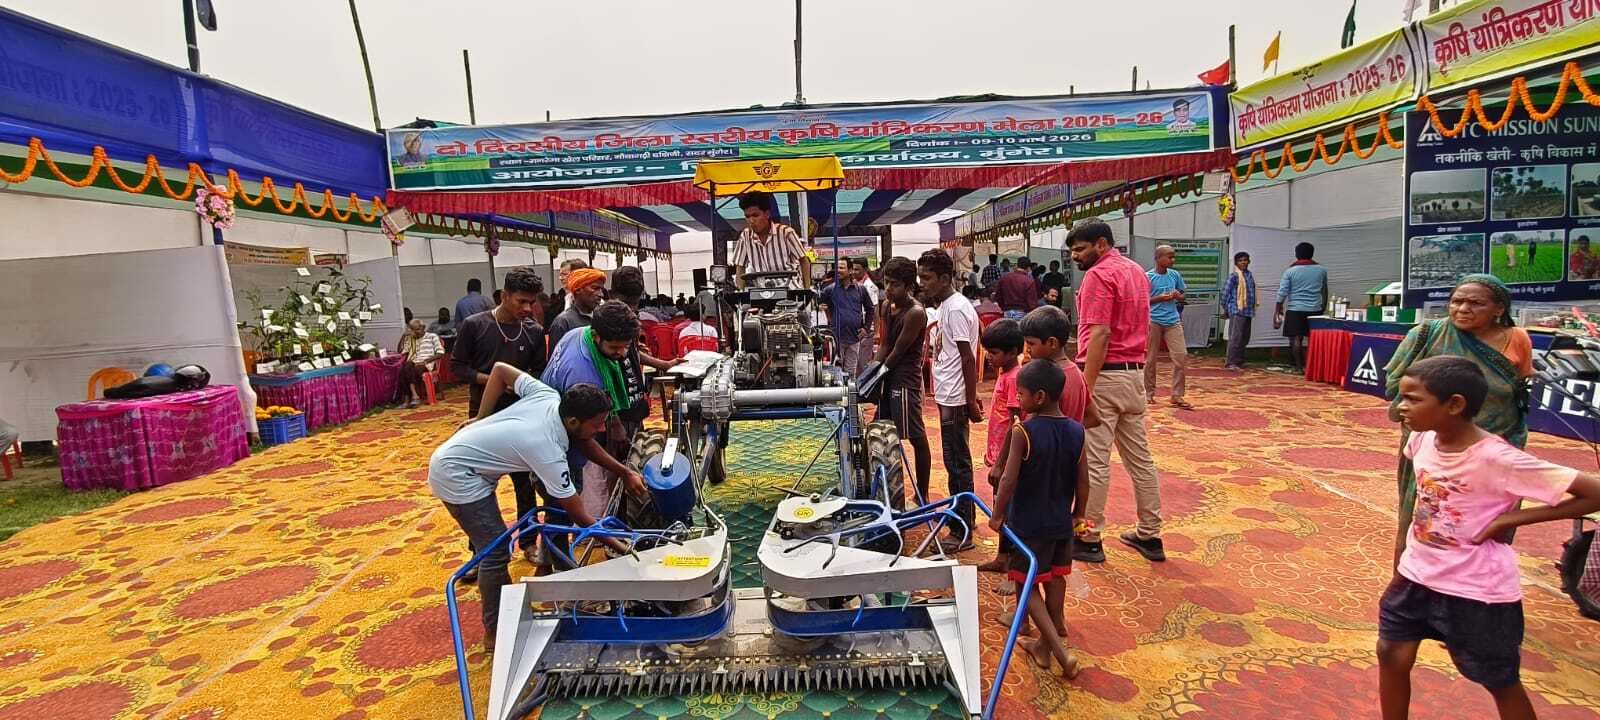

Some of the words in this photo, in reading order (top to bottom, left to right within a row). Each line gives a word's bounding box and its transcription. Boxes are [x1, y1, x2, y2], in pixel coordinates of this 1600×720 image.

[1433, 22, 1470, 76] कृषि
[1470, 0, 1565, 52] यांत्रिकरण
[1237, 104, 1257, 140] कृषि
[1256, 96, 1302, 127] यांत्रिकरण
[1301, 83, 1338, 110] योजना
[434, 141, 468, 155] दो
[474, 136, 588, 154] दिवसीय
[594, 133, 674, 149] जिला
[679, 127, 772, 145] स्तरीय
[777, 122, 841, 145] कृषि
[845, 120, 987, 138] यांत्रिकरण
[991, 115, 1057, 133] मेला
[1487, 117, 1558, 138] MISSION
[1563, 114, 1600, 133] SUN
[905, 140, 950, 148] दिनांक
[971, 137, 1016, 145] 09-10
[1018, 135, 1046, 144] मार्च
[1049, 133, 1092, 142] 2026
[1520, 144, 1544, 162] कृषि
[1547, 144, 1584, 158] विकास
[1587, 141, 1597, 157] में
[491, 166, 627, 180] आयोजक
[561, 470, 571, 489] 3
